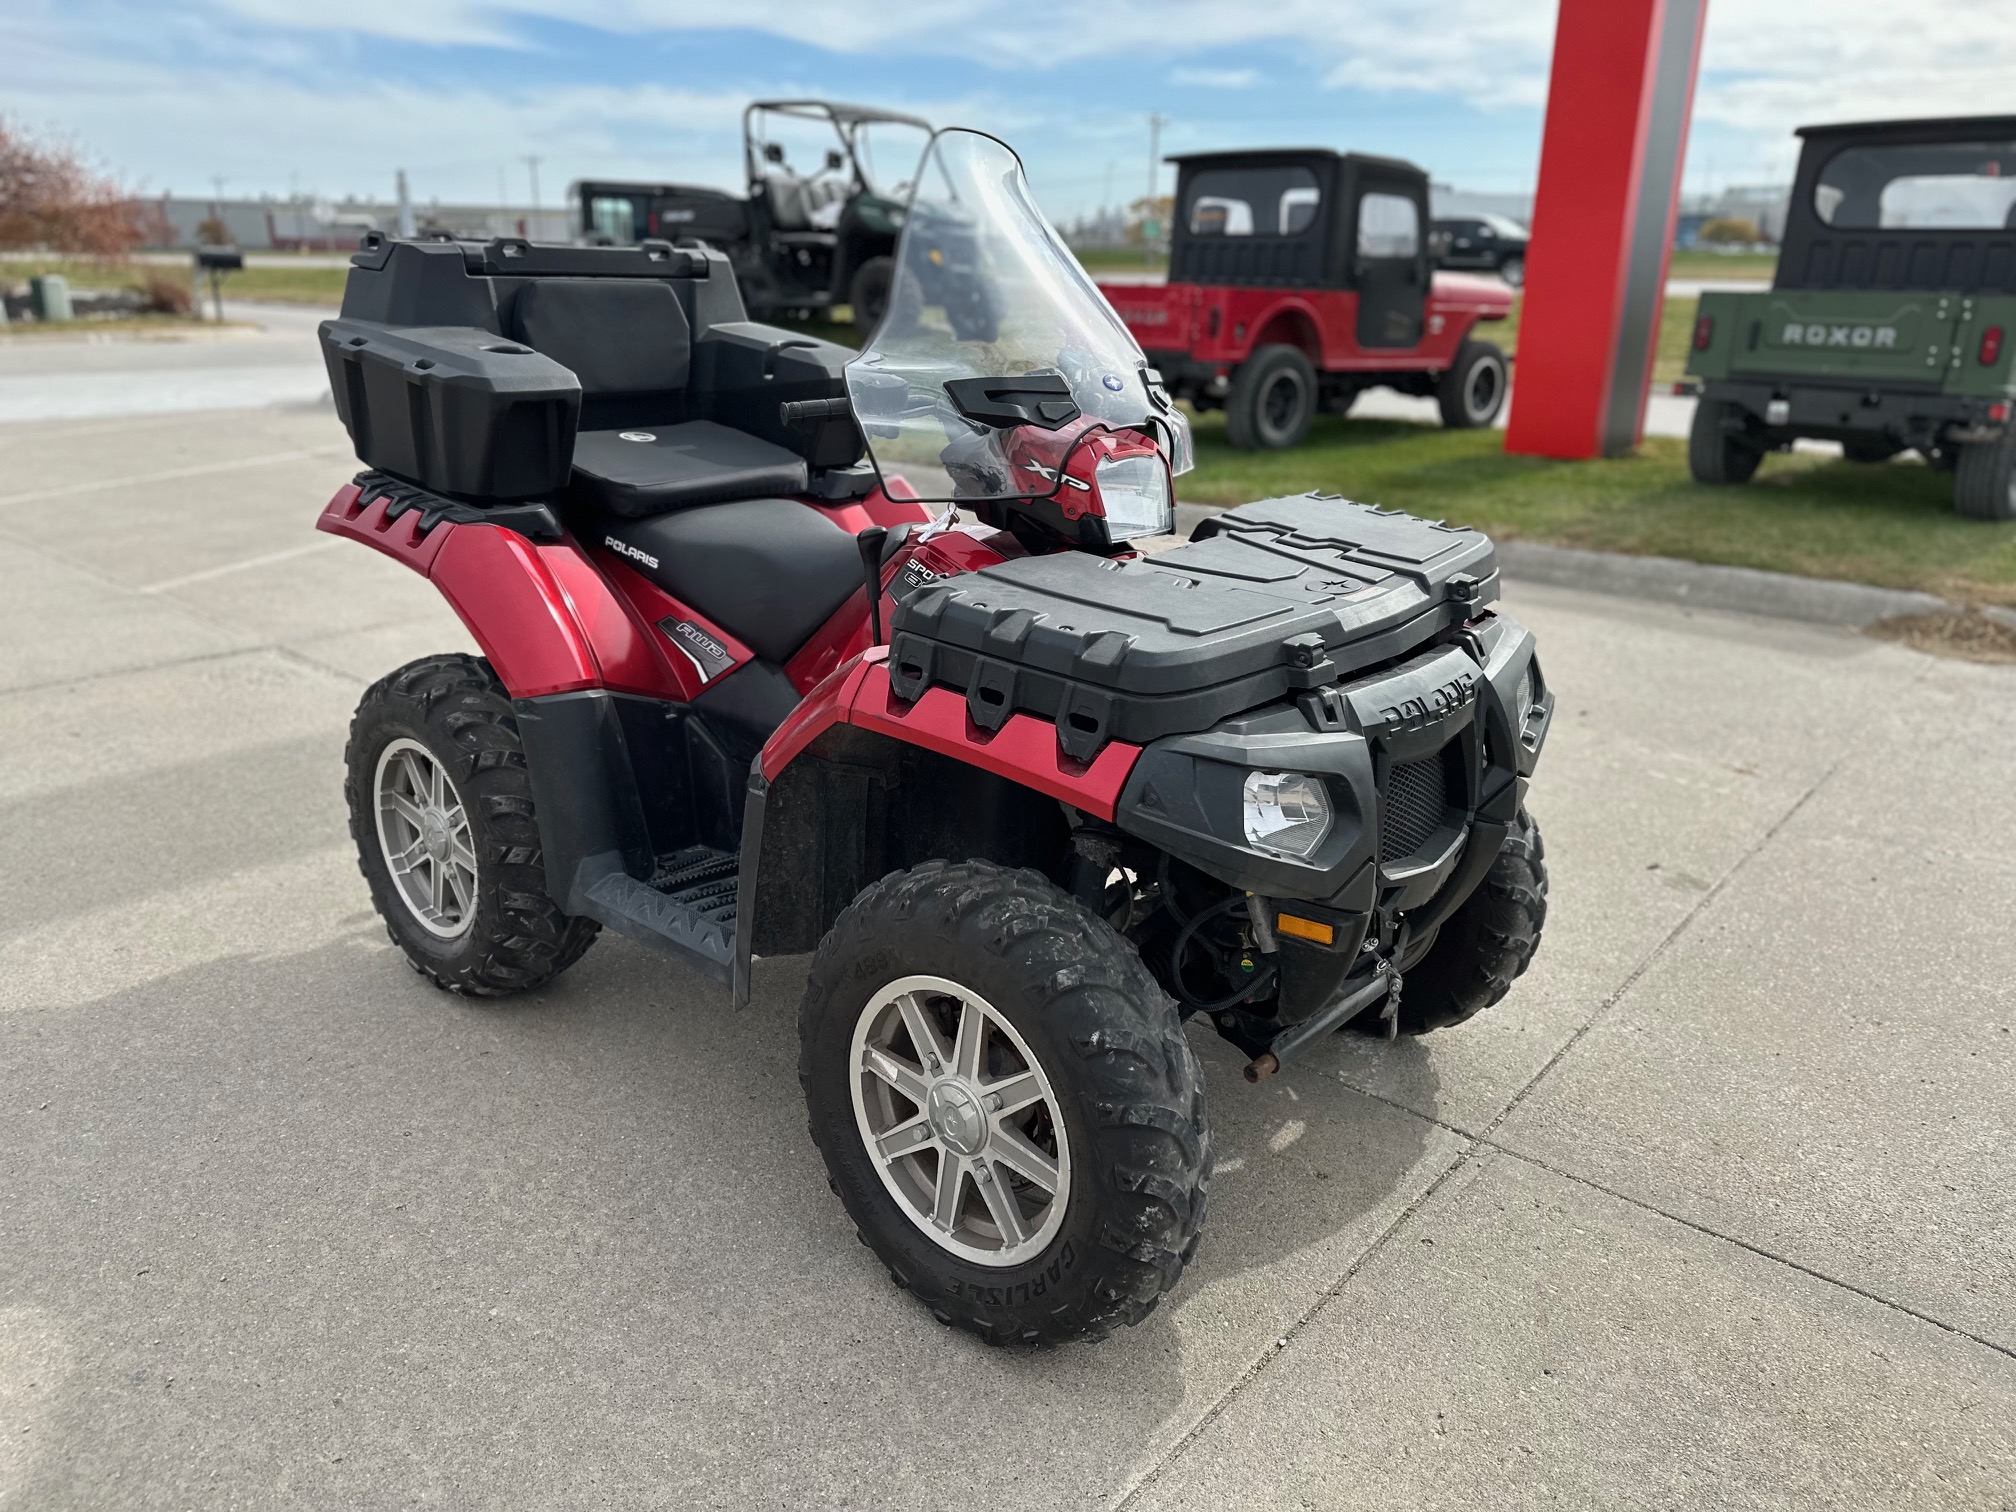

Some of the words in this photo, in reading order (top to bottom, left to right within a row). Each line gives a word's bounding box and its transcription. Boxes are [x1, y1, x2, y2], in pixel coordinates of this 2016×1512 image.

[1782, 323, 1897, 348] ROXOR
[1021, 456, 1092, 491] XP
[605, 536, 659, 569] POLARIS
[907, 558, 936, 580] SPO
[676, 622, 727, 660] AWD
[1379, 673, 1475, 740] POLARIS
[946, 1237, 1076, 1306] CARLISLE
